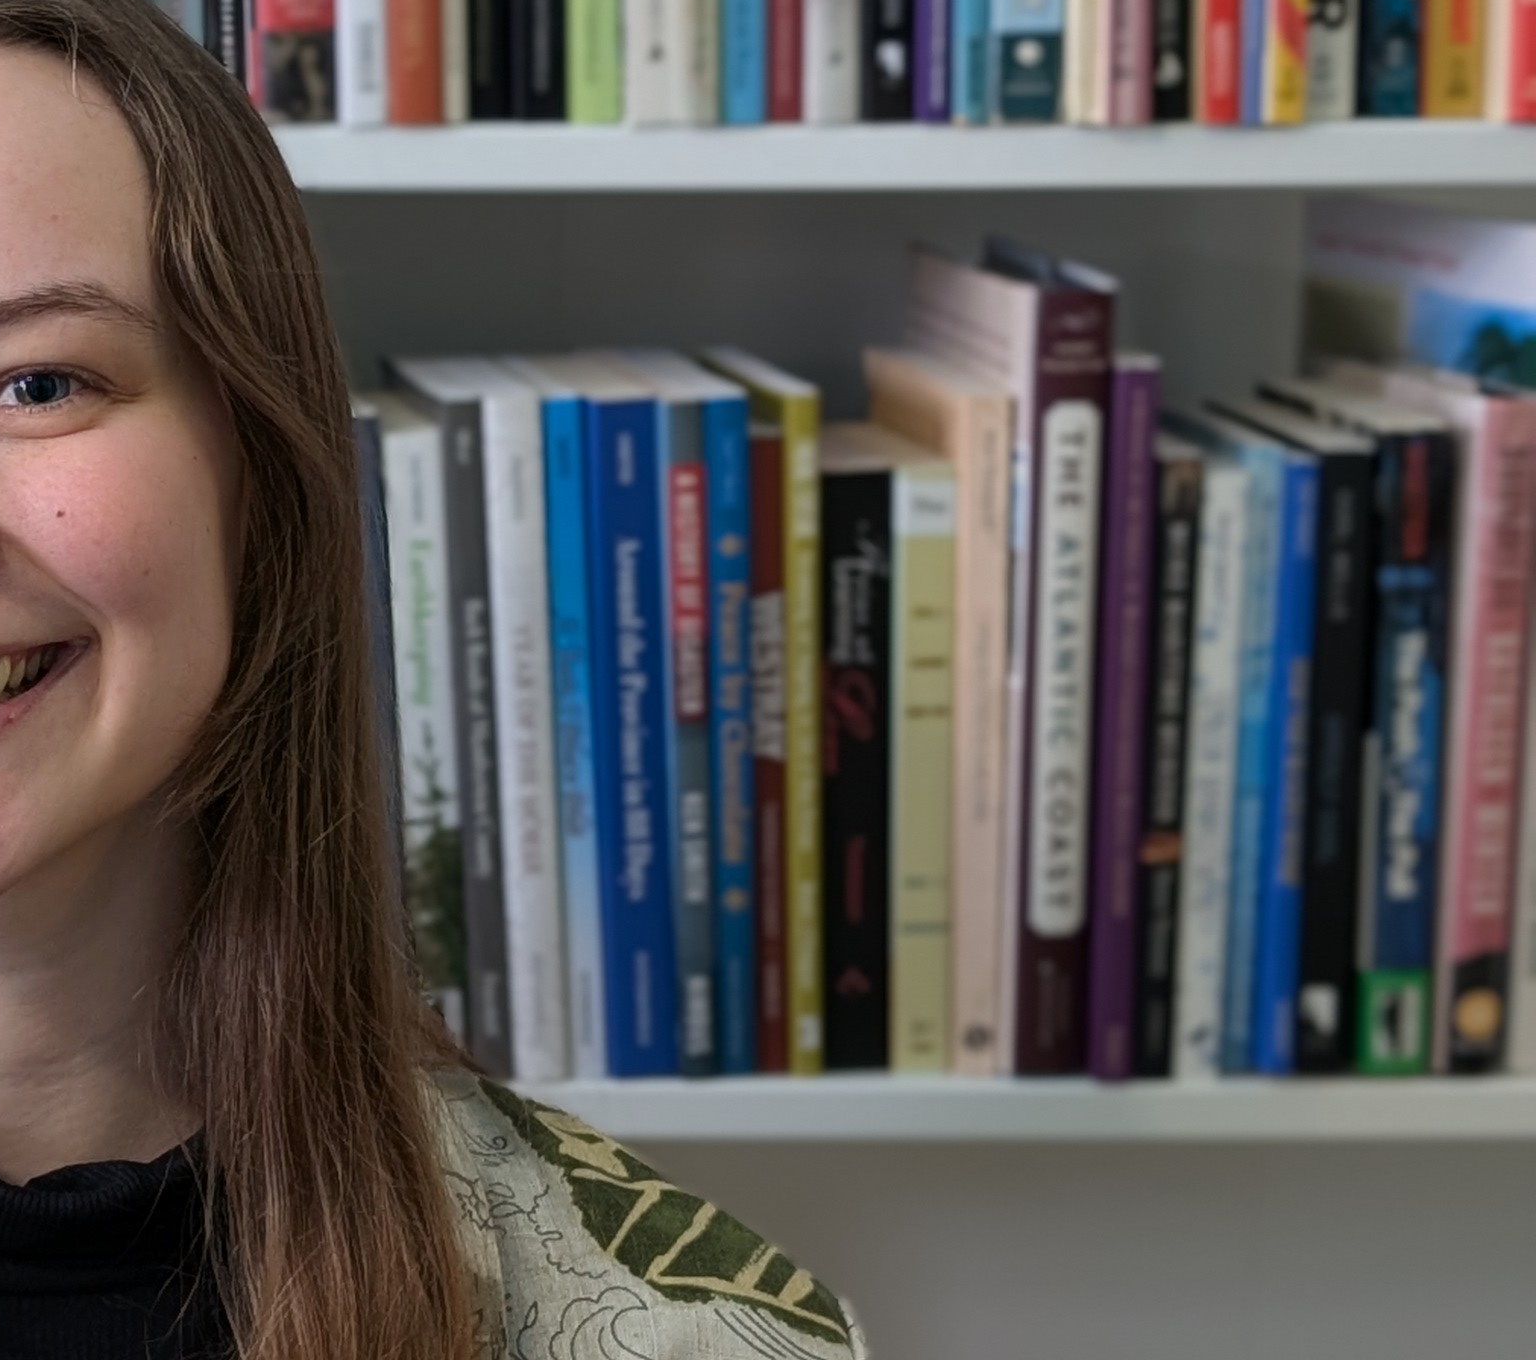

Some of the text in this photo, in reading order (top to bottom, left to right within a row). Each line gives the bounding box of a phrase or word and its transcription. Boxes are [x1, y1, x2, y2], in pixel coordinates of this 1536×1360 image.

[616, 536, 645, 626] Around
[619, 631, 645, 667] the
[751, 591, 785, 762] WESTRAY
[1042, 426, 1088, 914] THE ATLANTIC COAST
